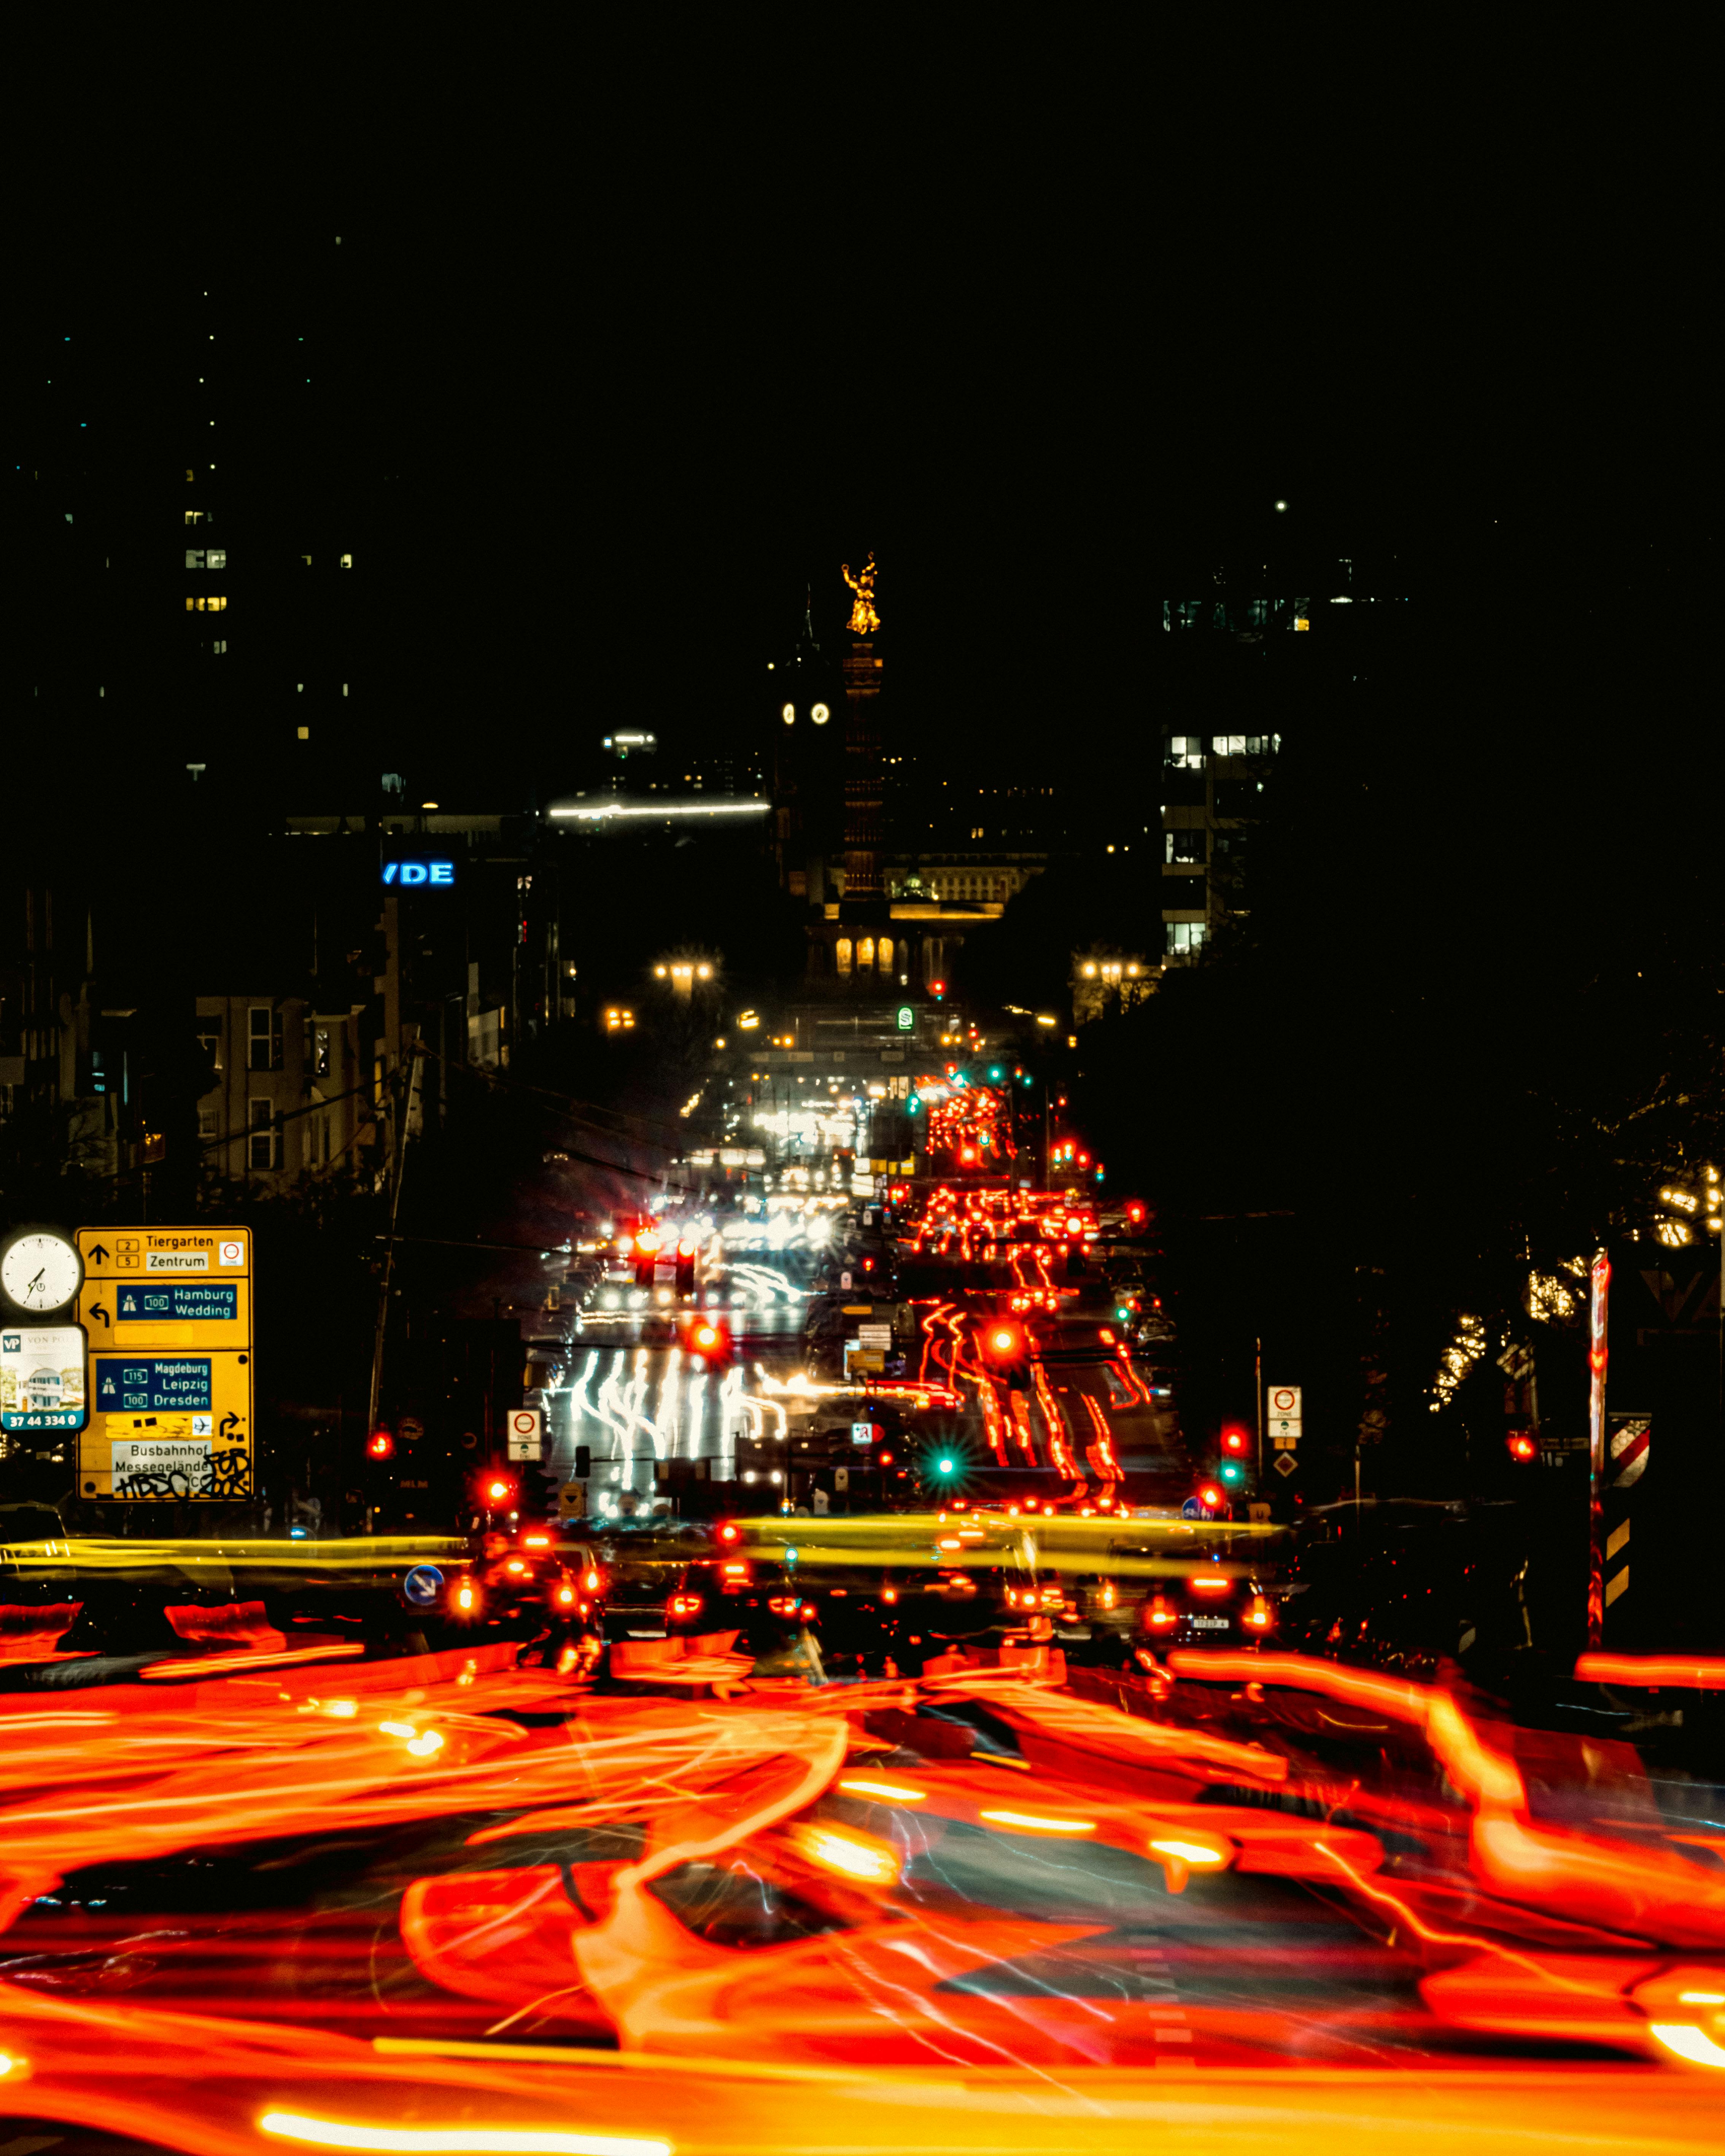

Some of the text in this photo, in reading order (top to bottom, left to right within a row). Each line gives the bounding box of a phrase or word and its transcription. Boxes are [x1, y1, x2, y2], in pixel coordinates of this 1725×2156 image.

[125, 1241, 131, 1250] 2
[146, 1236, 213, 1249] Tiergarten
[125, 1257, 131, 1266] 5
[151, 1256, 205, 1267] Zentrum
[174, 1289, 234, 1303] Hamburg
[175, 1304, 231, 1319] Wedding
[155, 1363, 208, 1376] Magdeburg
[129, 1372, 143, 1381] 115
[163, 1378, 208, 1392] Leipzig
[129, 1396, 143, 1405] 100
[154, 1395, 208, 1406] Dresden
[10, 1415, 76, 1427] 37 44 334 0
[131, 1445, 208, 1456] Busbahnhof
[115, 1461, 208, 1473] Messegelände
